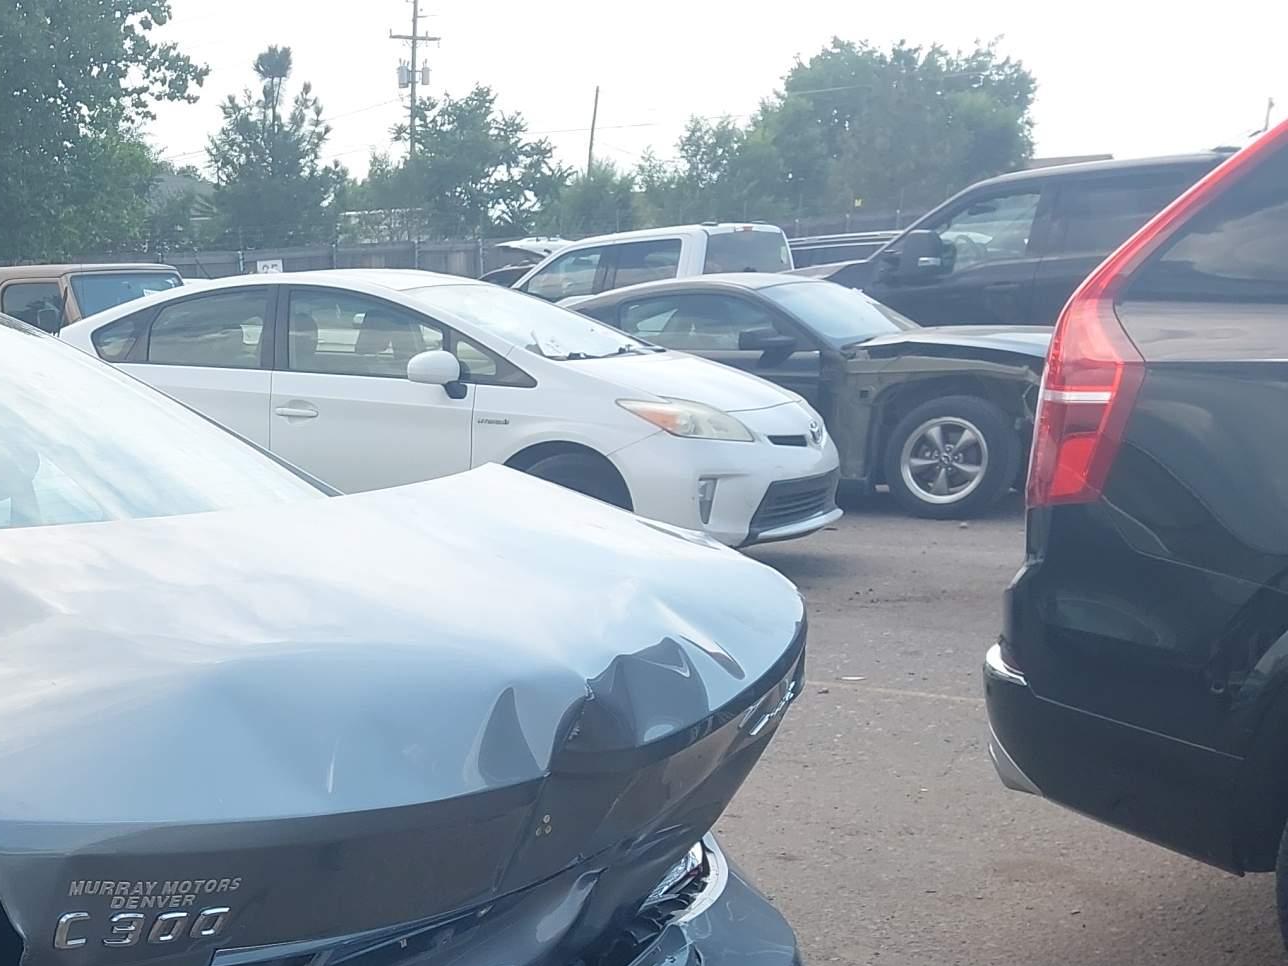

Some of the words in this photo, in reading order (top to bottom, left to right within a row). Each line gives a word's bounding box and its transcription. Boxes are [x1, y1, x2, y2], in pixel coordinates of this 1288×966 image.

[68, 880, 159, 896] MURRAY
[161, 877, 242, 895] MOTORS
[110, 894, 196, 909] DENVER
[53, 912, 90, 949] C
[102, 907, 231, 947] 300
